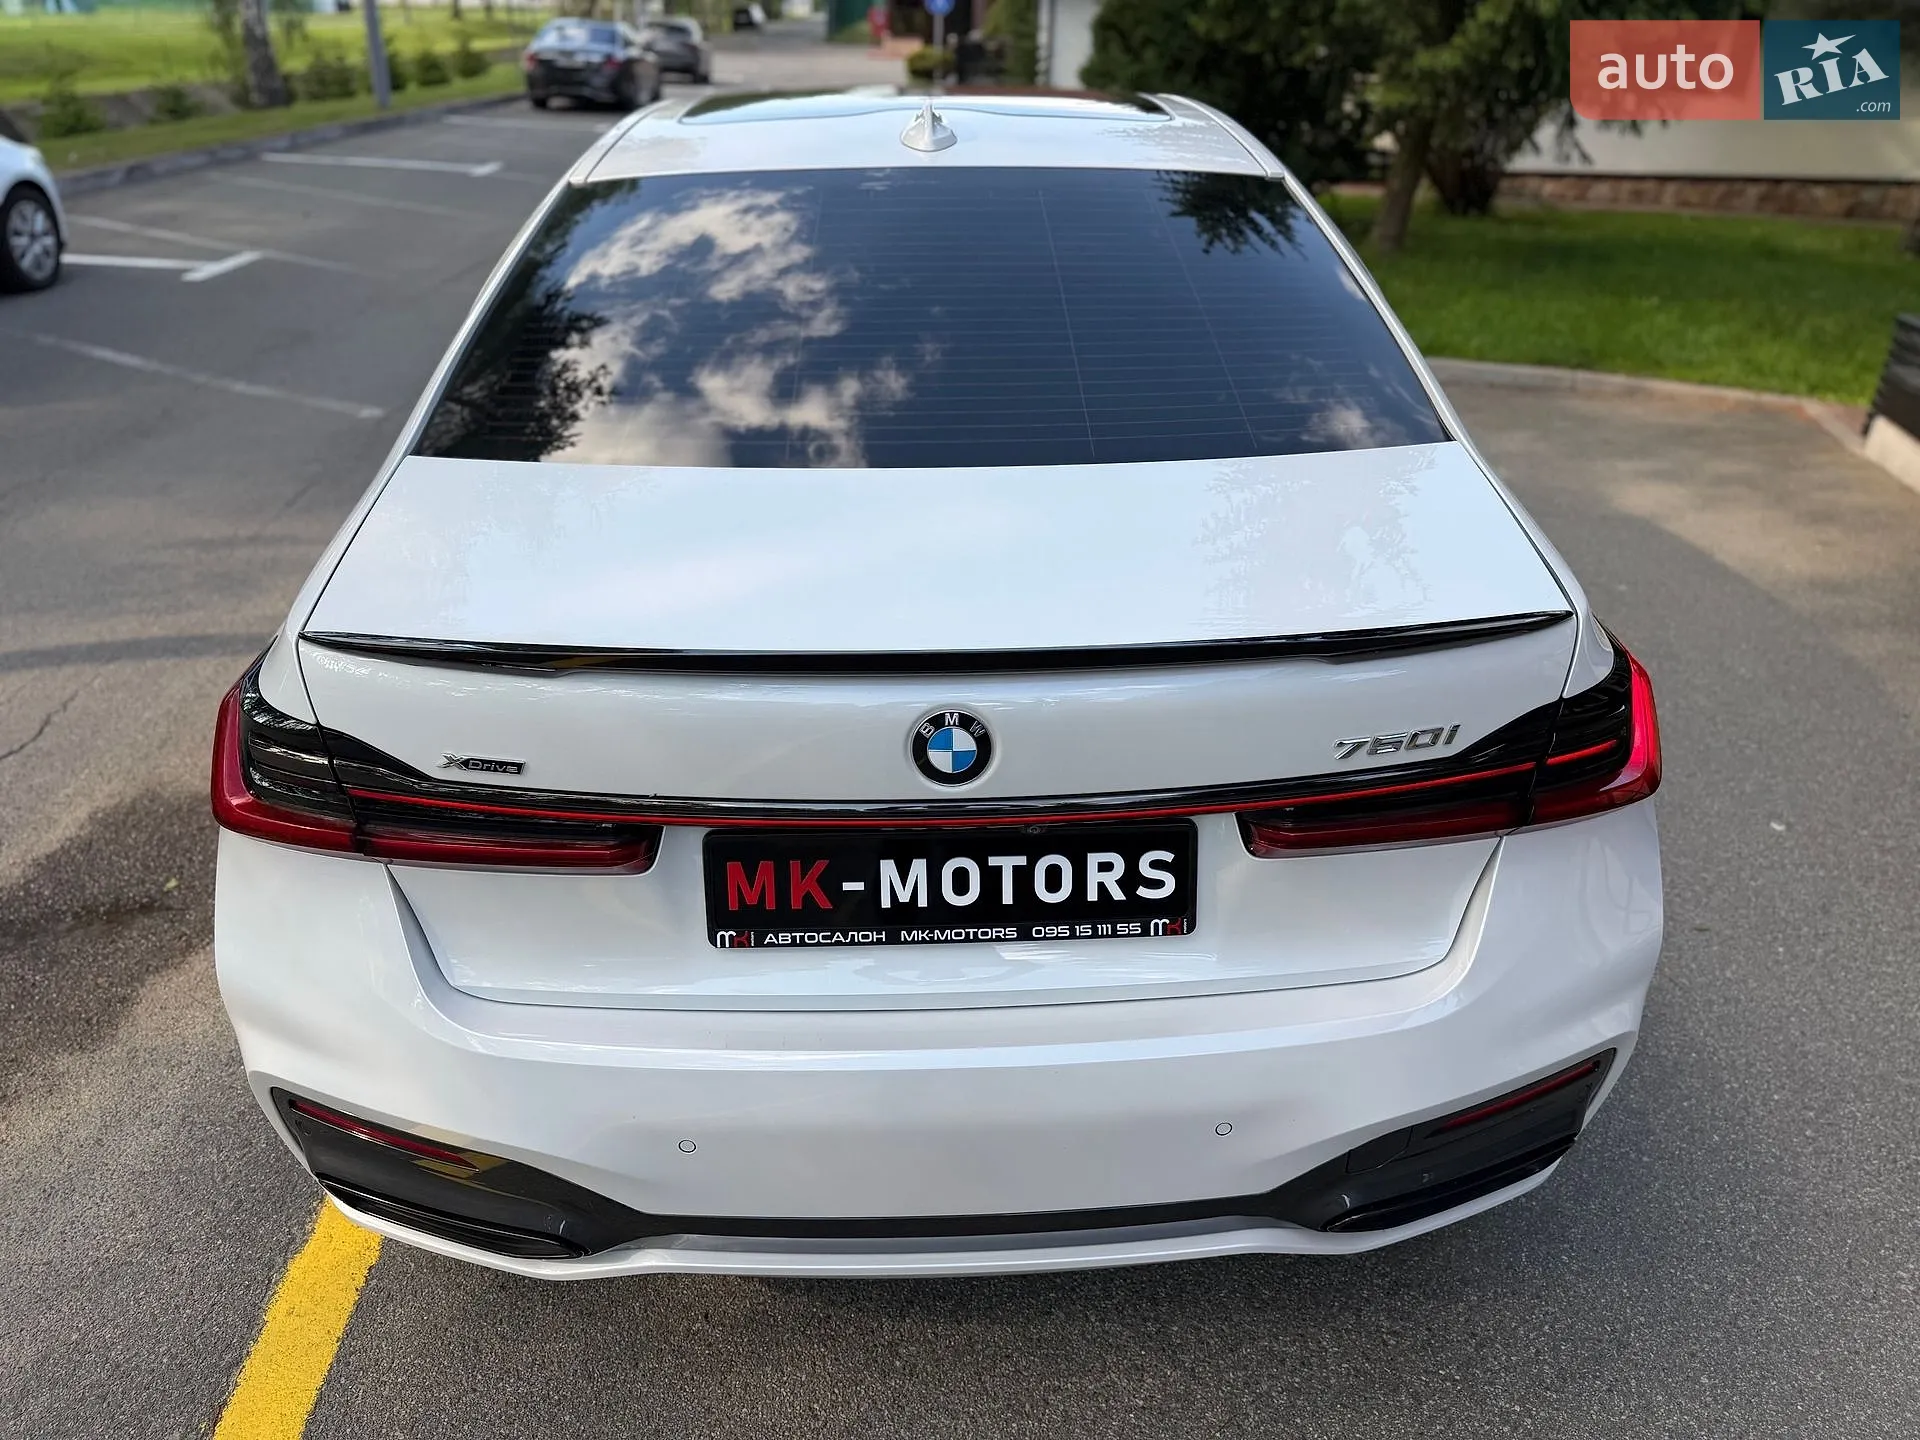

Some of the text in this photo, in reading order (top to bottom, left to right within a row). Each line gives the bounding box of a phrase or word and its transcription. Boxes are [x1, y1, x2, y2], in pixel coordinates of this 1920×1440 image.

[919, 712, 986, 739] BMW
[726, 850, 1177, 911] MK-MOTORS
[763, 930, 886, 945] АВТОСАЛОН
[900, 927, 1018, 942] MK-MOTORS
[1031, 925, 1070, 938] 095
[1075, 924, 1092, 937] 15
[1096, 923, 1112, 936] 111
[1116, 922, 1142, 935] 55
